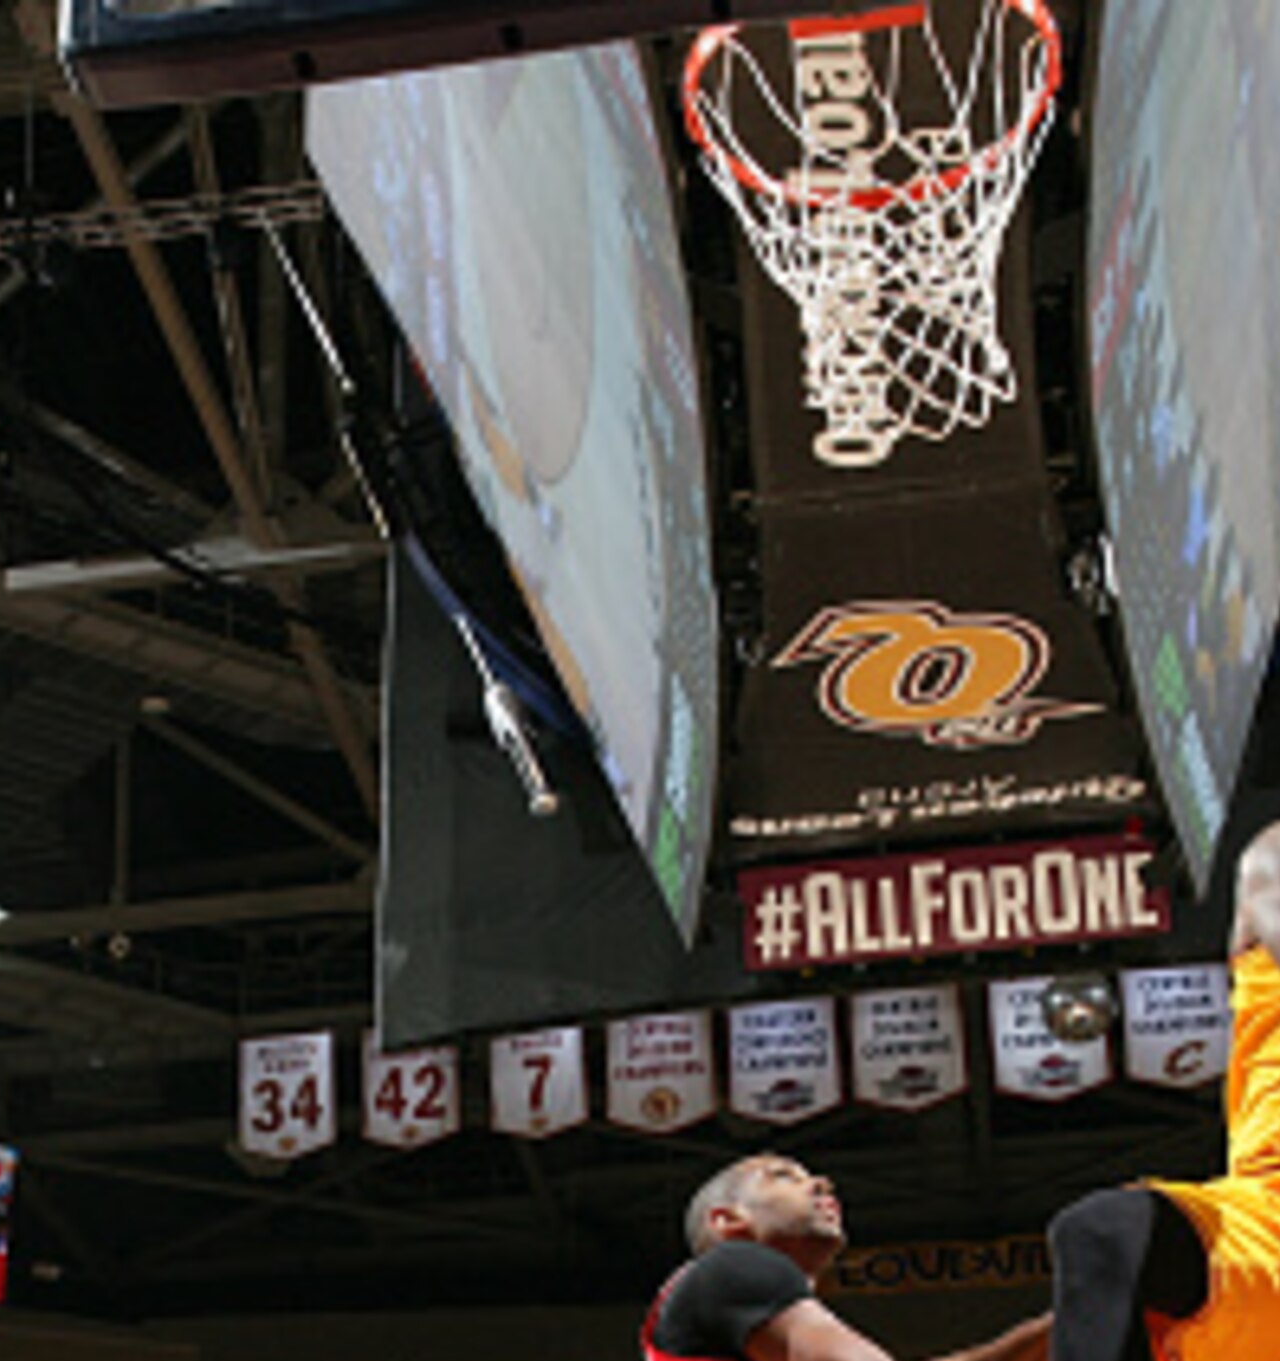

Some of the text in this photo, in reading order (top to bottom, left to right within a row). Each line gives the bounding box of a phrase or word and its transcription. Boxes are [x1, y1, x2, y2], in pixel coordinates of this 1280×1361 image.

[252, 1075, 322, 1132] 34
[374, 1065, 446, 1121] 42
[522, 1055, 551, 1111] 7
